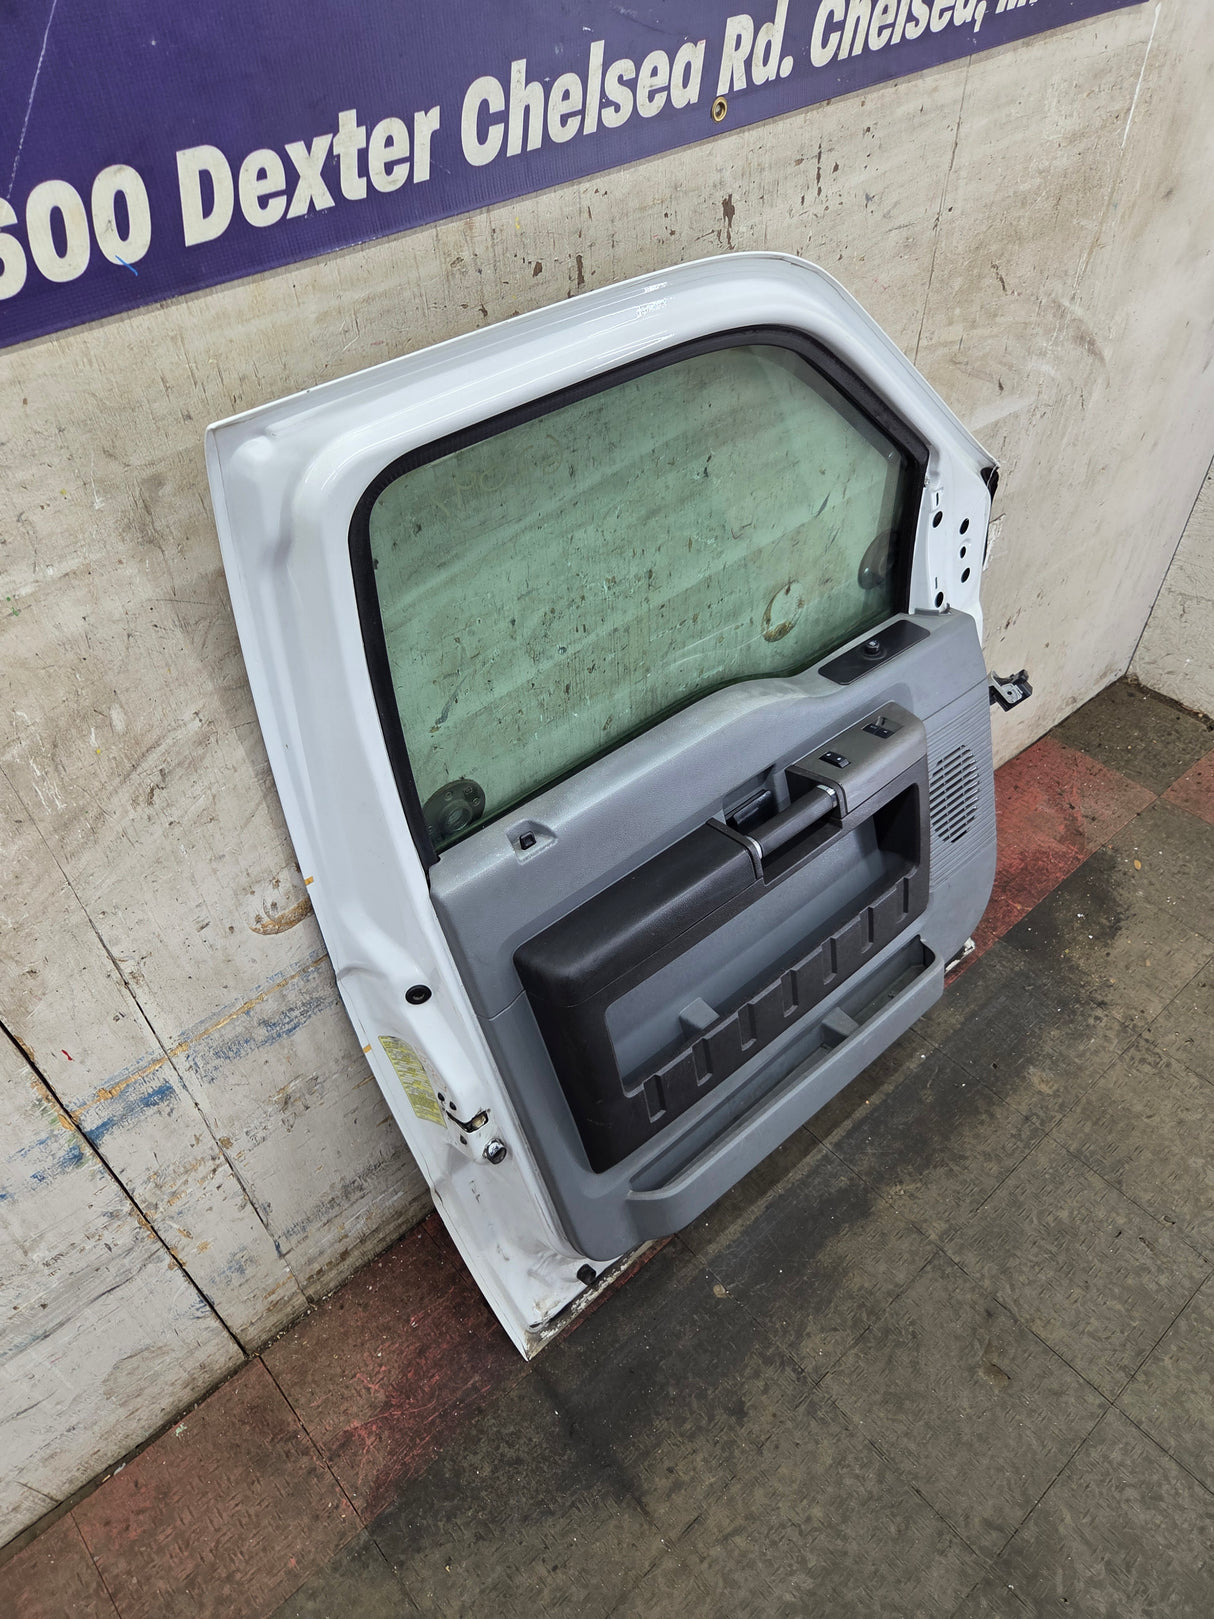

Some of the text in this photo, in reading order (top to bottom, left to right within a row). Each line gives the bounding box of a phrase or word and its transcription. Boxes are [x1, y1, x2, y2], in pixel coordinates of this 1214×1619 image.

[176, 106, 441, 248] Dexter
[461, 40, 706, 168] Chelsea
[717, 0, 795, 98] Rd.
